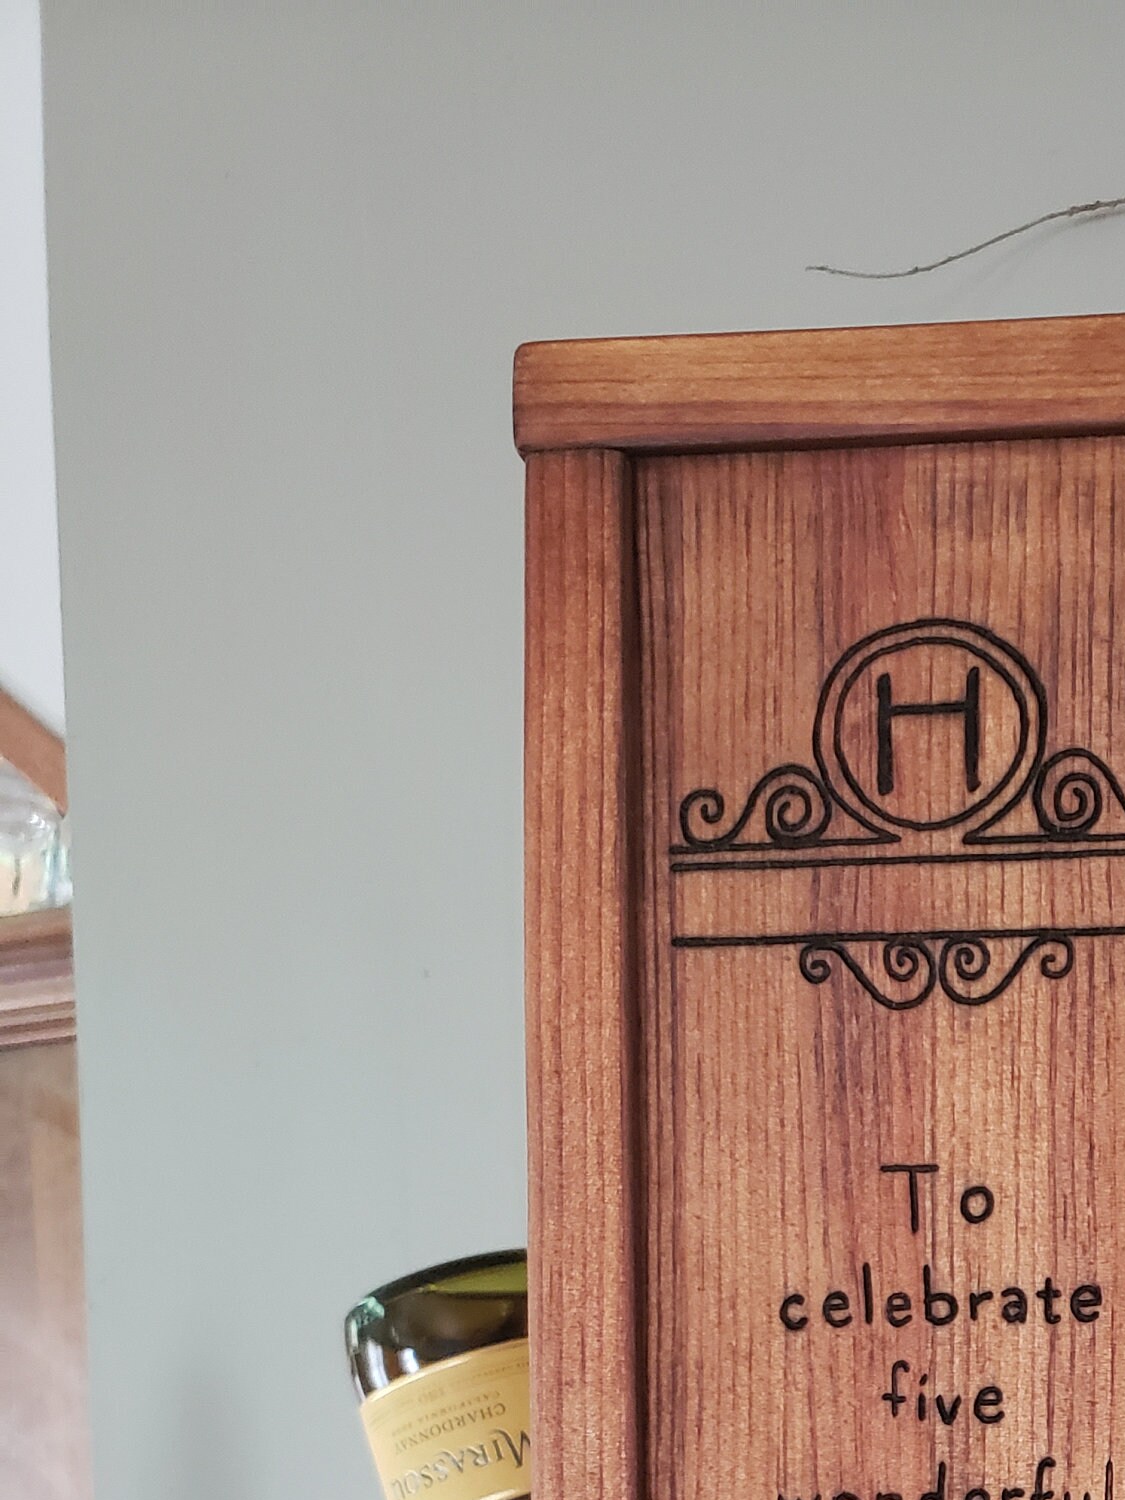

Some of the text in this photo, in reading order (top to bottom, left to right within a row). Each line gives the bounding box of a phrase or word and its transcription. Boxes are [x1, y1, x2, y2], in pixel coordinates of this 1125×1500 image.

[877, 666, 981, 796] H
[880, 1163, 995, 1234] To
[779, 1262, 1102, 1331] celebrate
[881, 1360, 1005, 1425] five
[394, 1402, 507, 1455] CHARDONNAY
